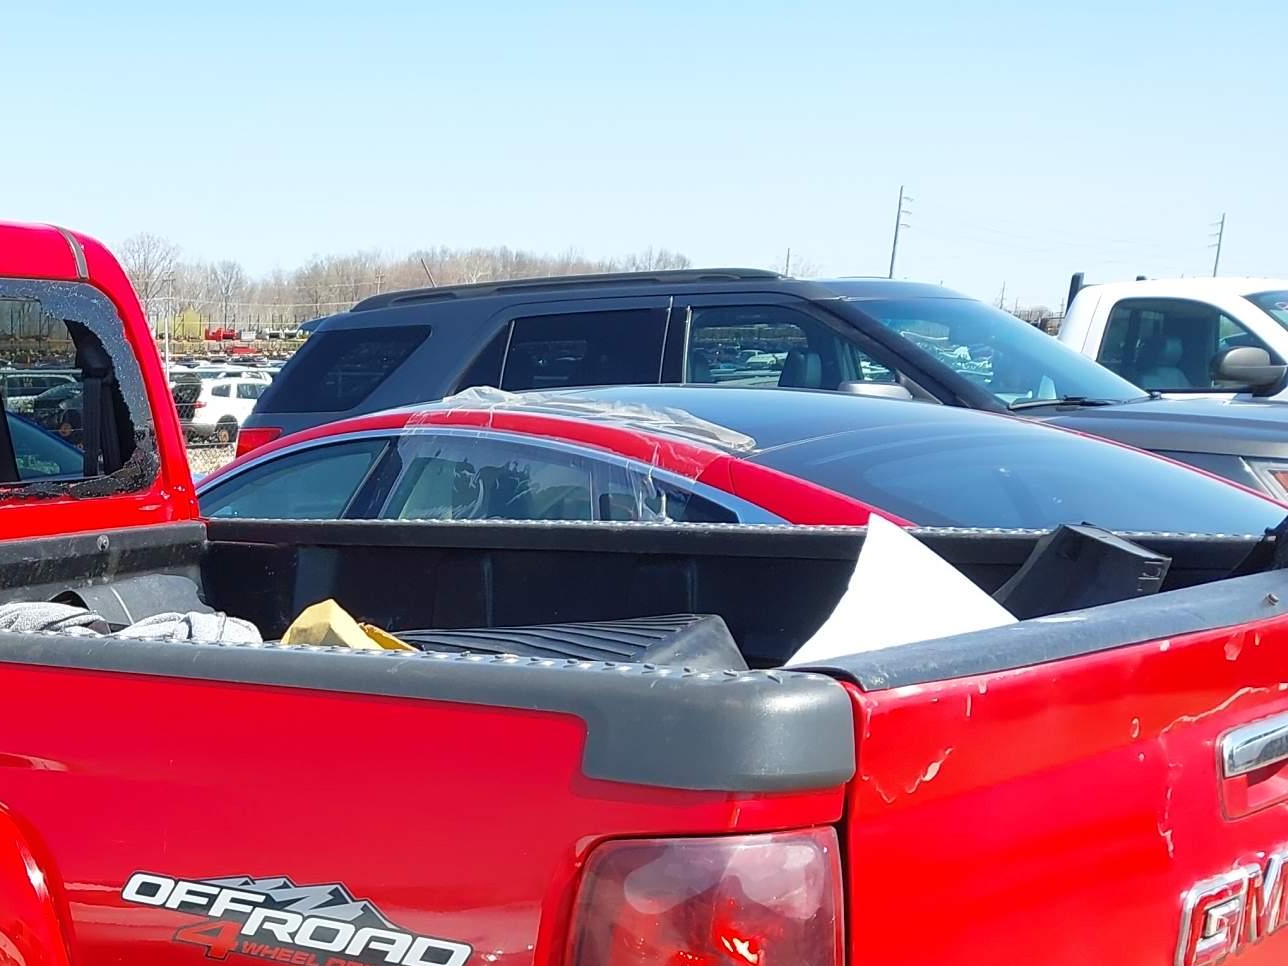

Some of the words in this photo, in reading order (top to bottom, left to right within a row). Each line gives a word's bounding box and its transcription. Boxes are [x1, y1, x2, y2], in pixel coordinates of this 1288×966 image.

[121, 872, 267, 917] OFF
[177, 920, 239, 958] 4
[242, 940, 320, 966] WHEEL
